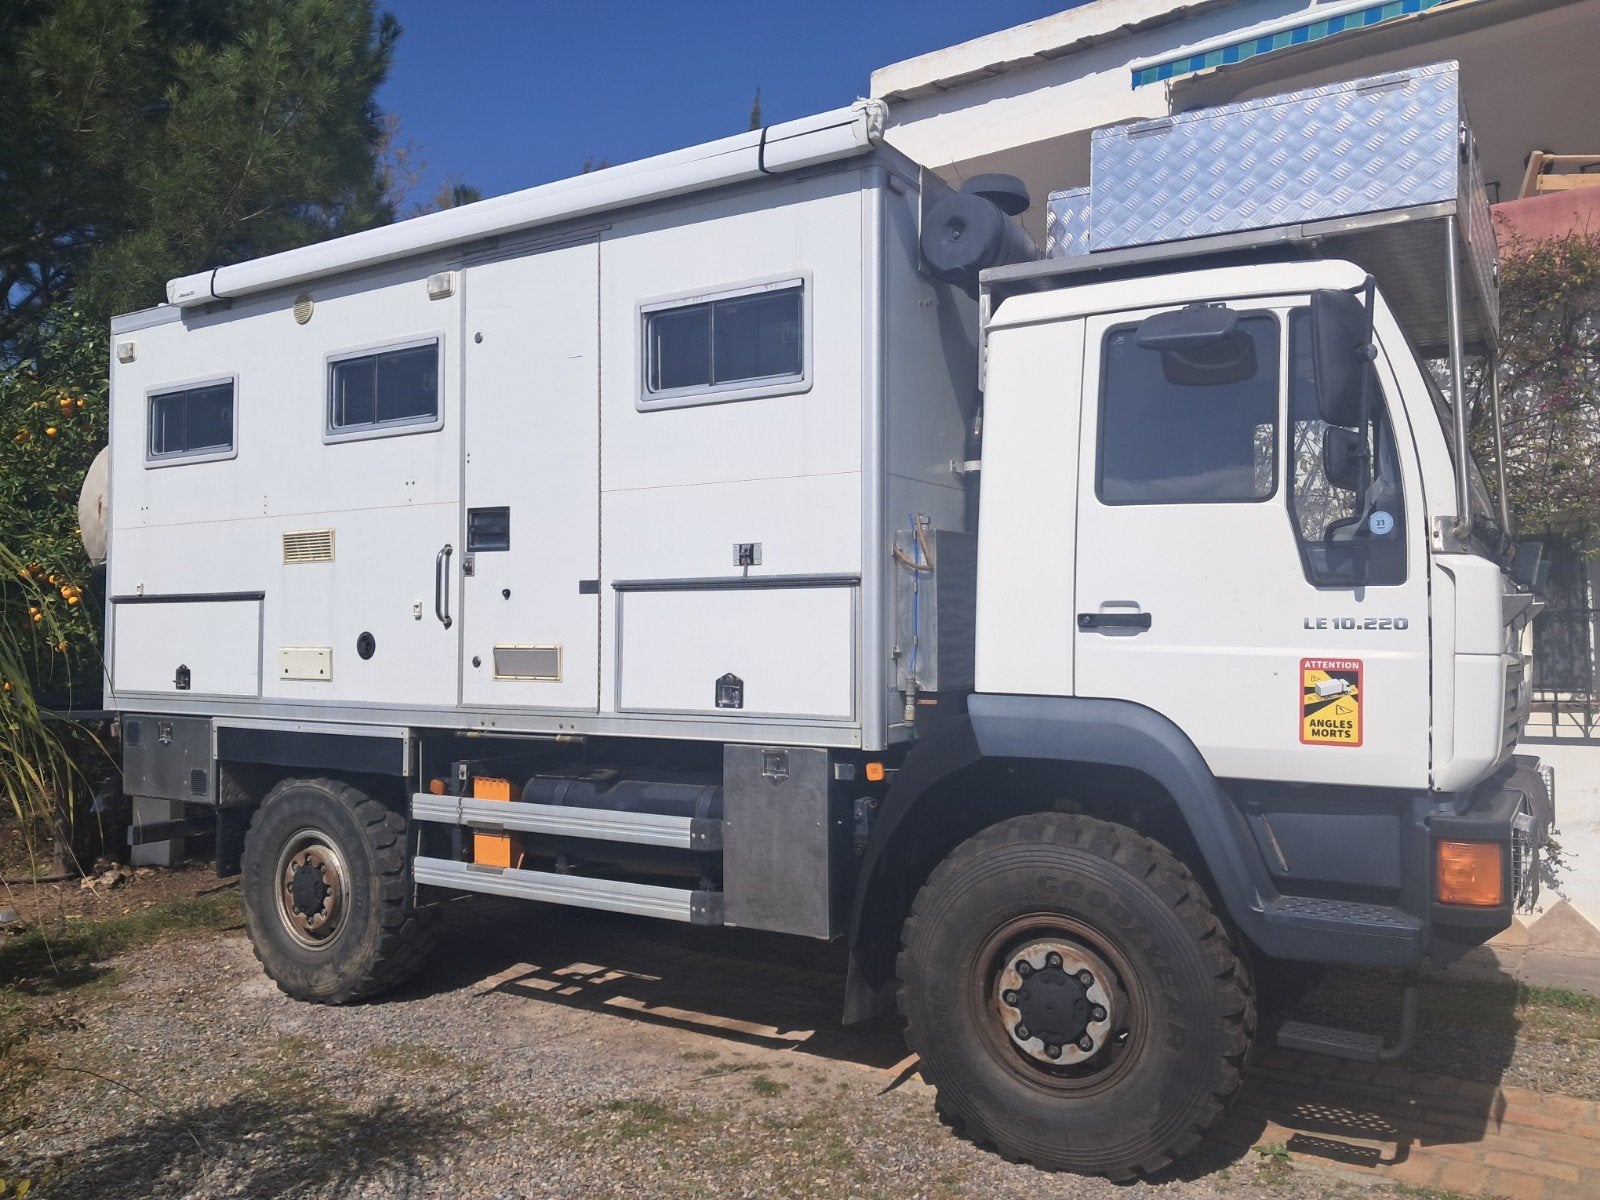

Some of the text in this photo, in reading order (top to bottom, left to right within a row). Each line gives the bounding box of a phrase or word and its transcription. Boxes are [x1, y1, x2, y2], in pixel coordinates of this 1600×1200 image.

[1303, 617, 1409, 630] LE 10.220
[1304, 660, 1359, 669] ATTENTION
[1309, 719, 1353, 729] ANGLES
[1311, 729, 1351, 738] MORTS
[1036, 875, 1186, 1051] GOODYEAR
